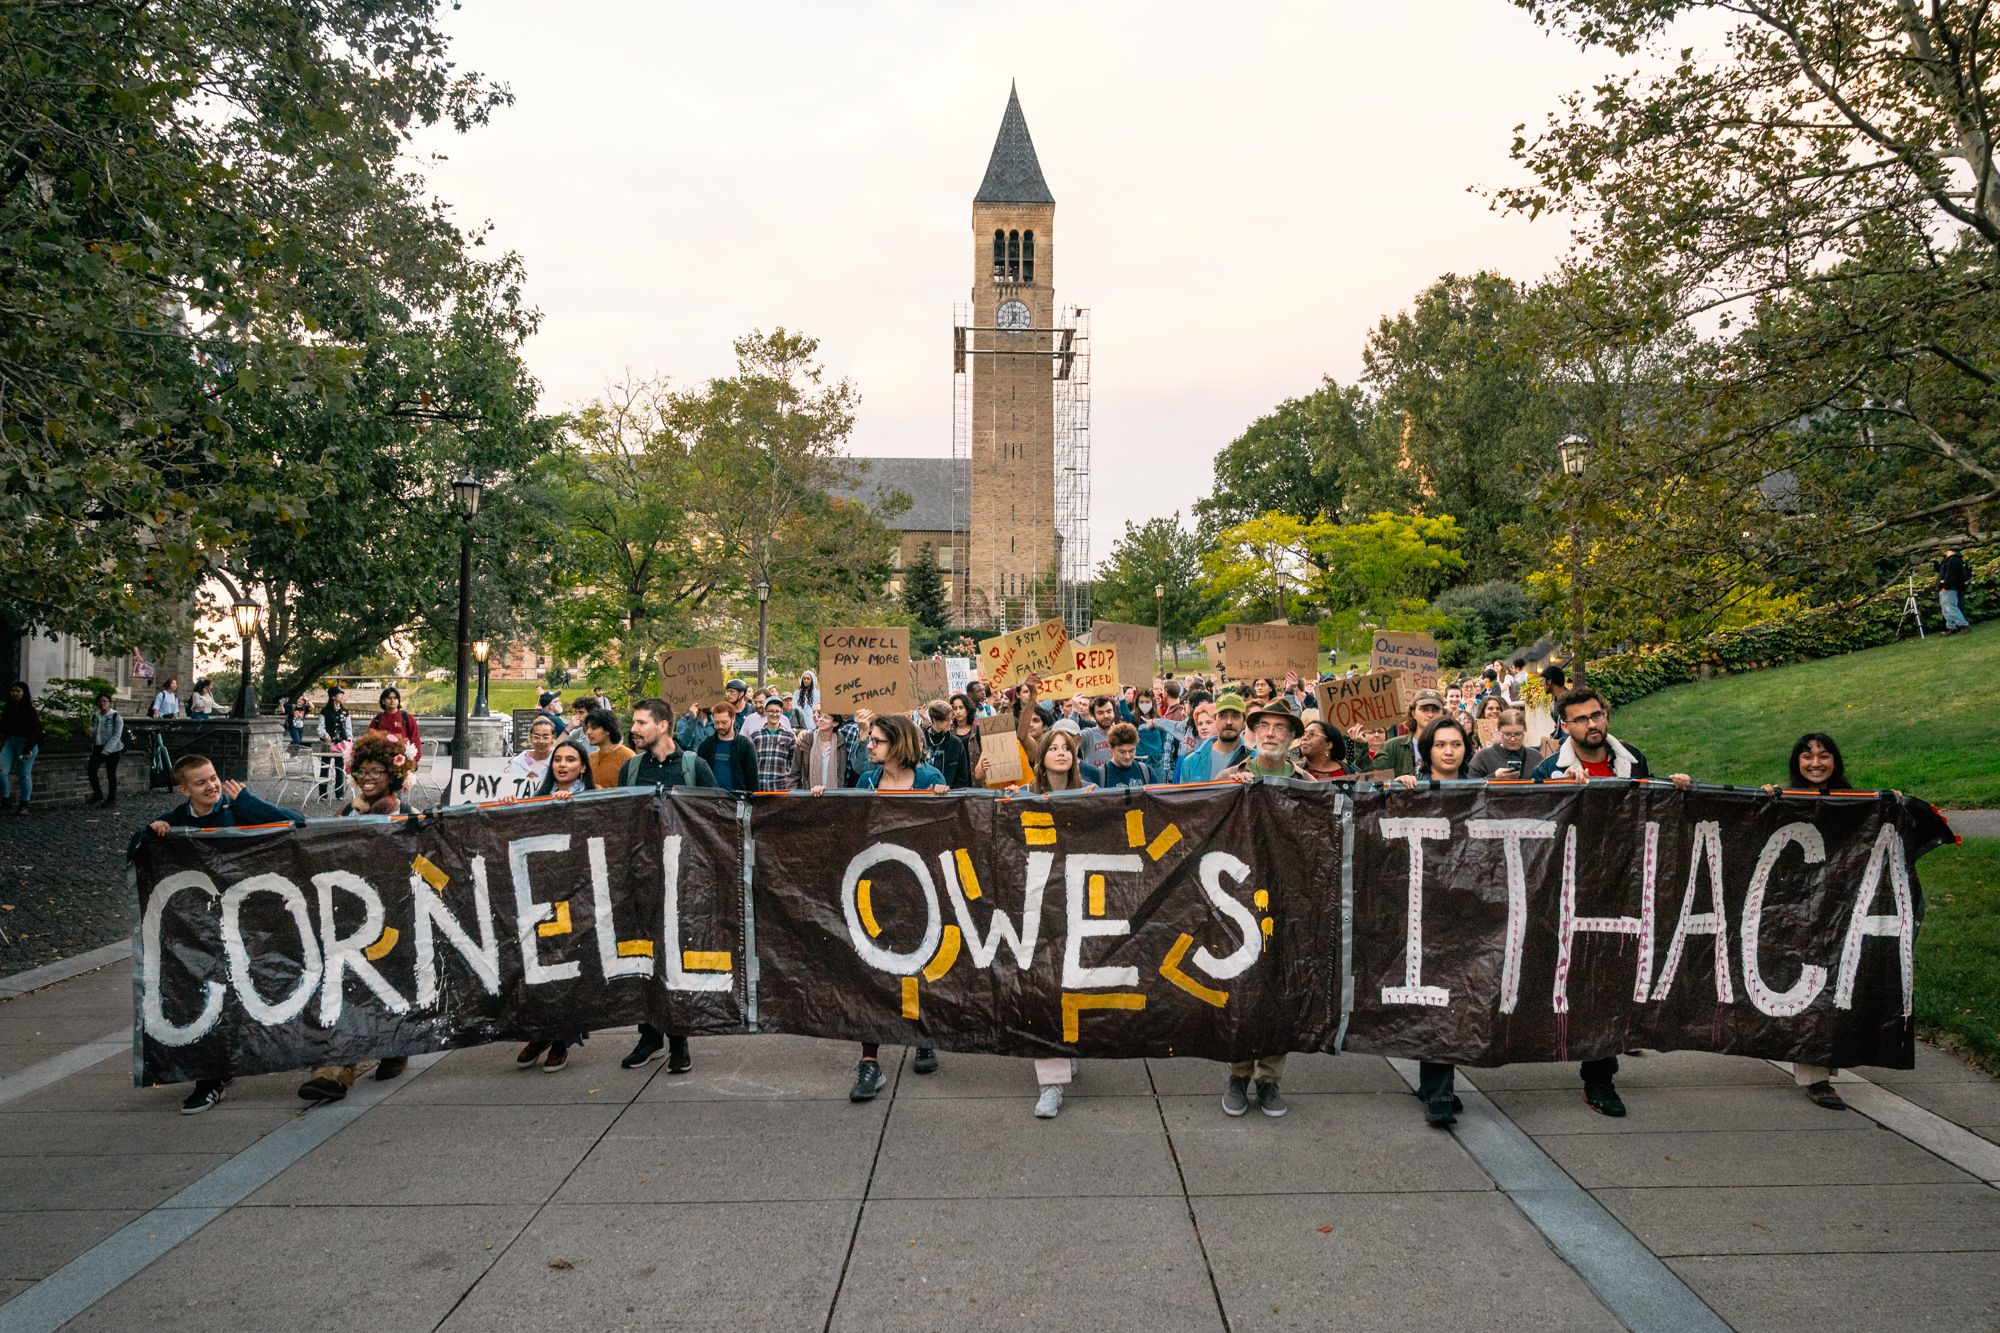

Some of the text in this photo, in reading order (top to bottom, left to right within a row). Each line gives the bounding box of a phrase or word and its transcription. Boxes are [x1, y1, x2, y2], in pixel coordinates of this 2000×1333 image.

[823, 634, 898, 649] CORNELL
[1015, 630, 1040, 648] $8M
[1376, 638, 1437, 658] Our school
[834, 653, 900, 665] PAY MORE
[1027, 650, 1038, 658] IS
[1076, 649, 1115, 671] RED?
[1379, 656, 1417, 670] needs
[663, 654, 717, 678] Cornell
[989, 647, 1016, 690] CORNELL
[1016, 655, 1052, 677] FAIR!
[686, 676, 704, 687] Pay
[834, 678, 862, 695] SAVE
[1035, 679, 1063, 695] BIG
[1075, 674, 1114, 689] GREED!
[1326, 675, 1362, 702] PAY
[1370, 674, 1392, 693] UP
[1413, 673, 1438, 690] RED
[666, 690, 687, 705] Your
[852, 681, 897, 704] ITHACA!
[1327, 692, 1405, 727] CORNELL
[987, 735, 1007, 753] UP
[460, 773, 502, 799] PAY
[143, 818, 1914, 1047] CORNELL OWES ITHACA
